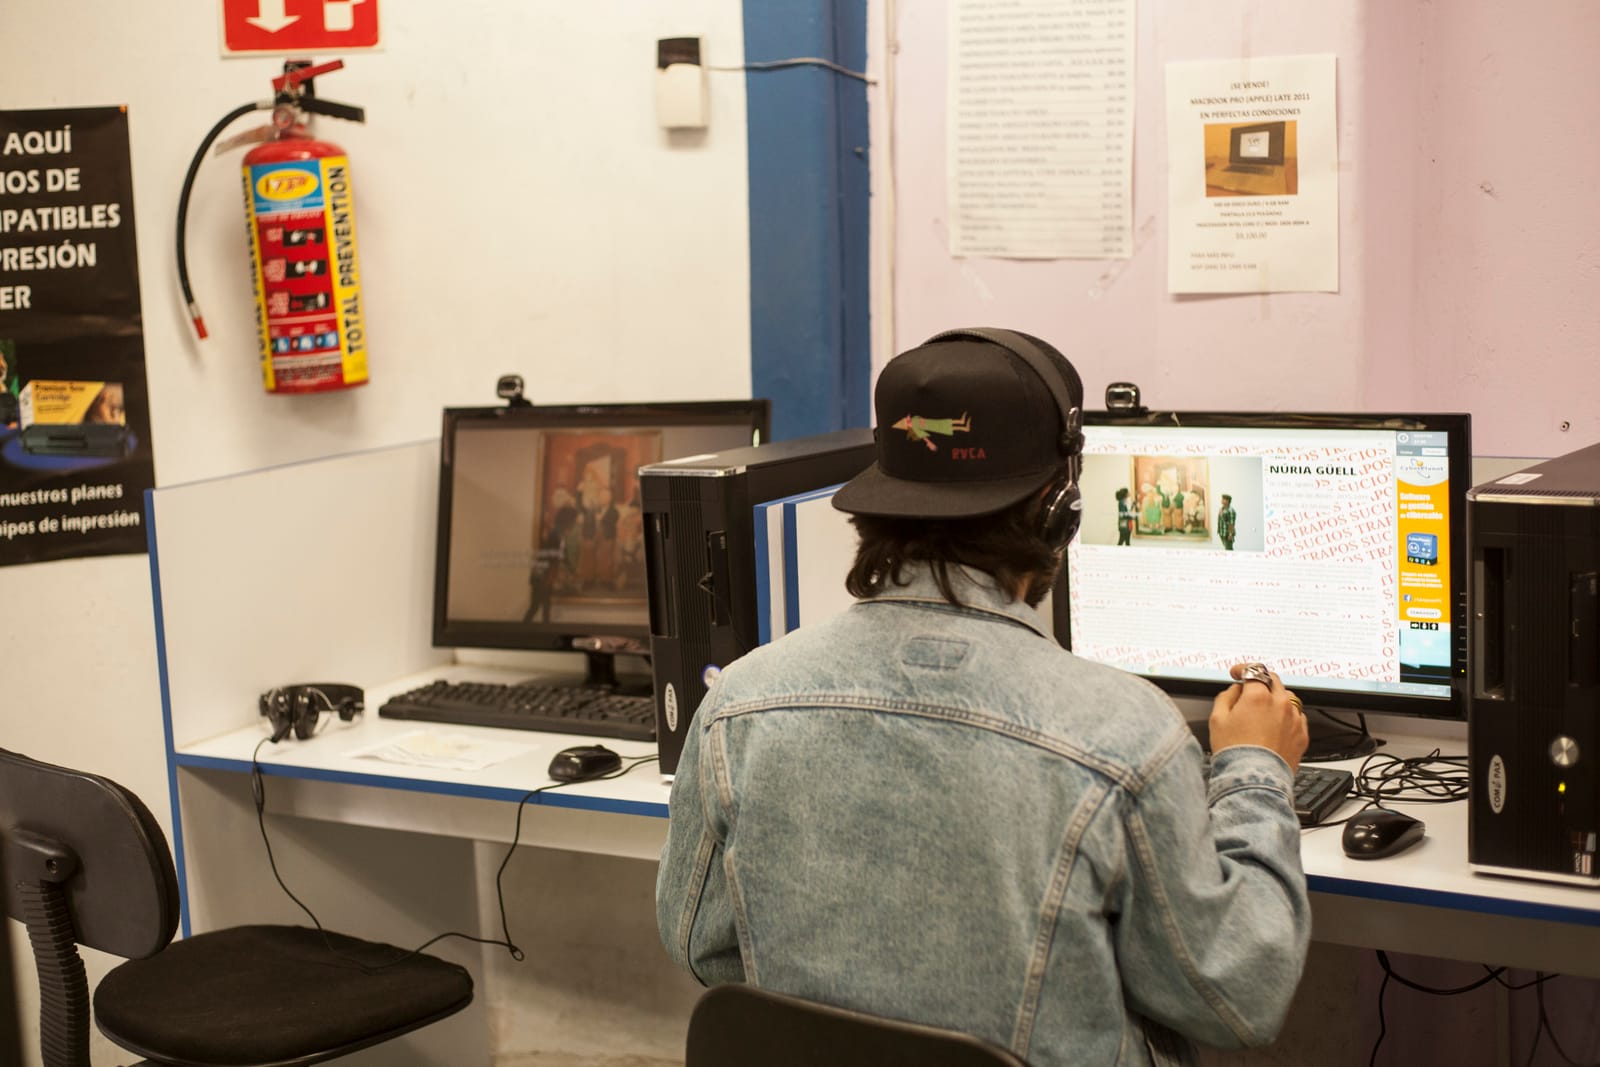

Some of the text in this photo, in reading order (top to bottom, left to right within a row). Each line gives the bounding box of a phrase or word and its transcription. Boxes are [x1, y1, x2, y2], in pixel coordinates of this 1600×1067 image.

[1274, 94, 1291, 102] LATE
[1293, 93, 1310, 101] 2011
[3, 125, 72, 155] AQUÍ
[46, 168, 81, 191] DE
[0, 239, 97, 271] RESIÓN
[329, 166, 363, 355] TOTAL PREVENTION
[952, 447, 986, 460] RVCA
[1269, 462, 1357, 476] NÚRIA GÜELL
[0, 483, 123, 507] nuestros planes
[39, 516, 58, 533] de
[62, 510, 141, 534] impresión
[1290, 514, 1348, 539] TRAPOS
[1294, 526, 1353, 552] SUCIOS
